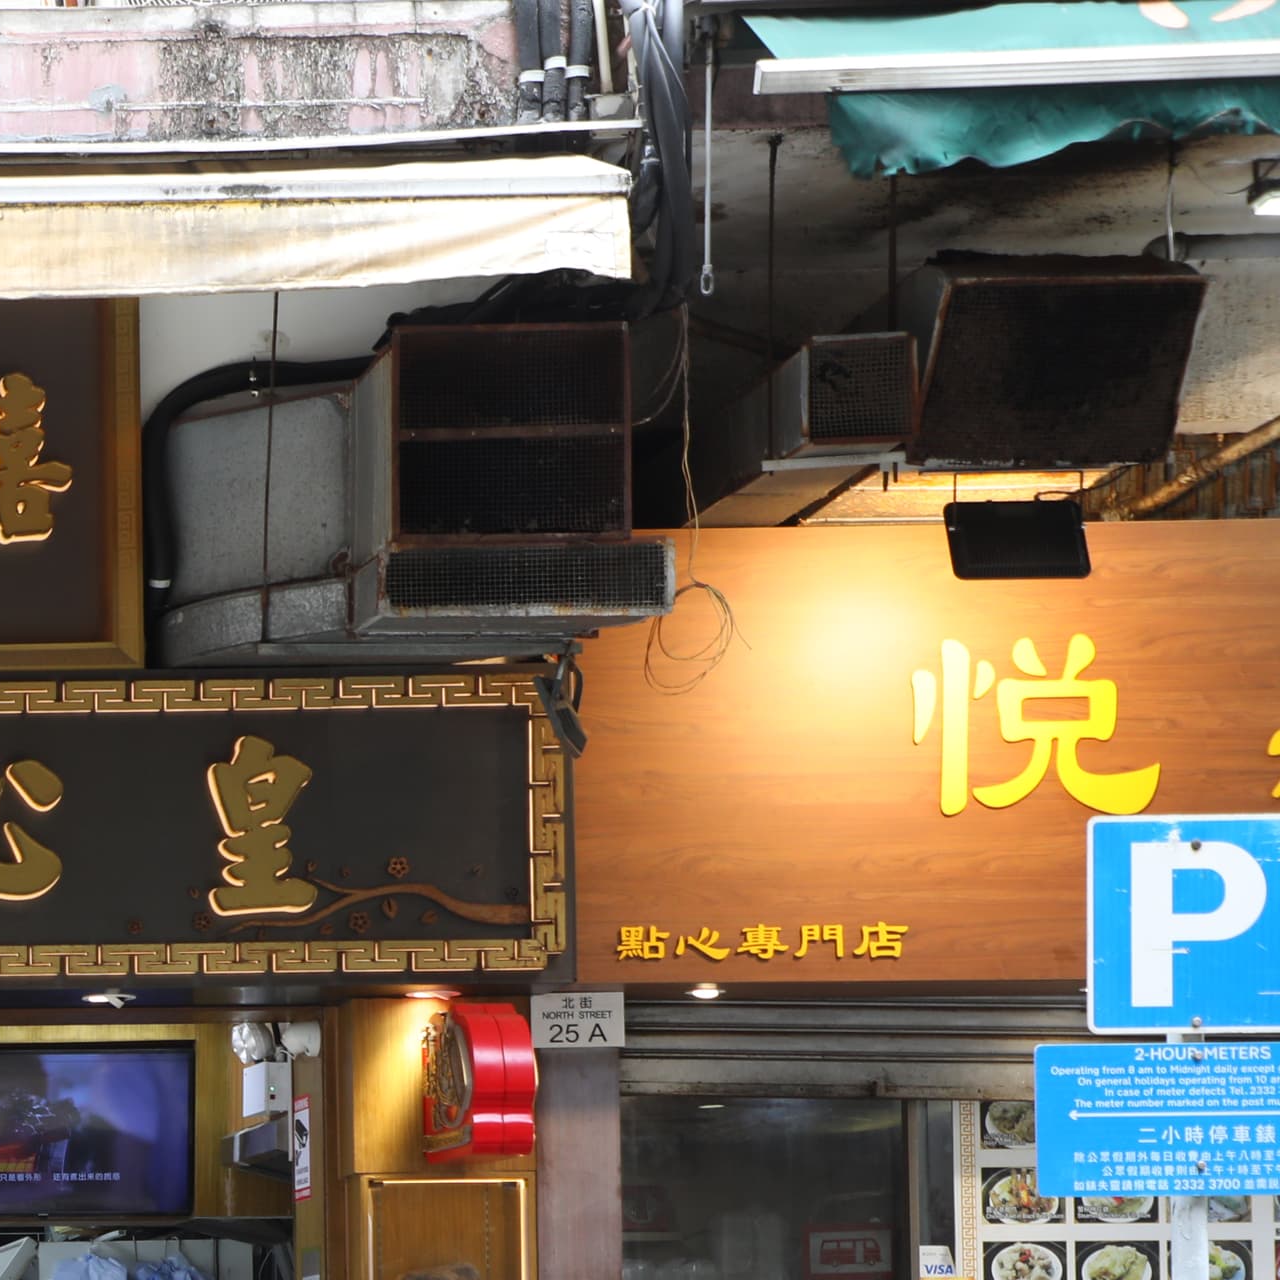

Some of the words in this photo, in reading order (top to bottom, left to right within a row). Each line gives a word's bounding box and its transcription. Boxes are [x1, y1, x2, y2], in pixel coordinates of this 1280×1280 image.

[1130, 841, 1268, 1007] P
[616, 922, 908, 961] 點心專門店
[562, 997, 592, 1009] 北街
[542, 1011, 574, 1019] NORTH
[578, 1010, 612, 1019] STREET
[549, 1023, 579, 1042] 25
[588, 1023, 607, 1042] A
[1204, 1046, 1271, 1060] METERS
[1051, 1066, 1099, 1076] Operating
[1102, 1066, 1125, 1074] from
[1156, 1066, 1167, 1074] to
[1170, 1065, 1210, 1075] Midnight
[1214, 1065, 1238, 1074] daily
[1241, 1066, 1275, 1075] except
[1078, 1078, 1092, 1086] On
[1096, 1078, 1131, 1087] general
[1135, 1077, 1176, 1086] holidays
[1179, 1076, 1226, 1086] operating
[1229, 1076, 1252, 1084] from
[1255, 1076, 1267, 1084] 10
[1105, 1088, 1114, 1096] In
[1143, 1088, 1154, 1096] of
[1157, 1088, 1186, 1096] meter
[1188, 1087, 1226, 1096] defects
[1250, 1086, 1275, 1095] 2332
[1075, 1099, 1092, 1107] The
[1128, 1099, 1165, 1107] number
[1167, 1098, 1204, 1107] marked
[1222, 1098, 1238, 1106] the
[1242, 1099, 1264, 1107] post
[1138, 1125, 1275, 1144] 二小時停車錶
[1174, 1179, 1204, 1190] 2332
[1209, 1178, 1240, 1190] 3700
[925, 1264, 953, 1274] VISA
